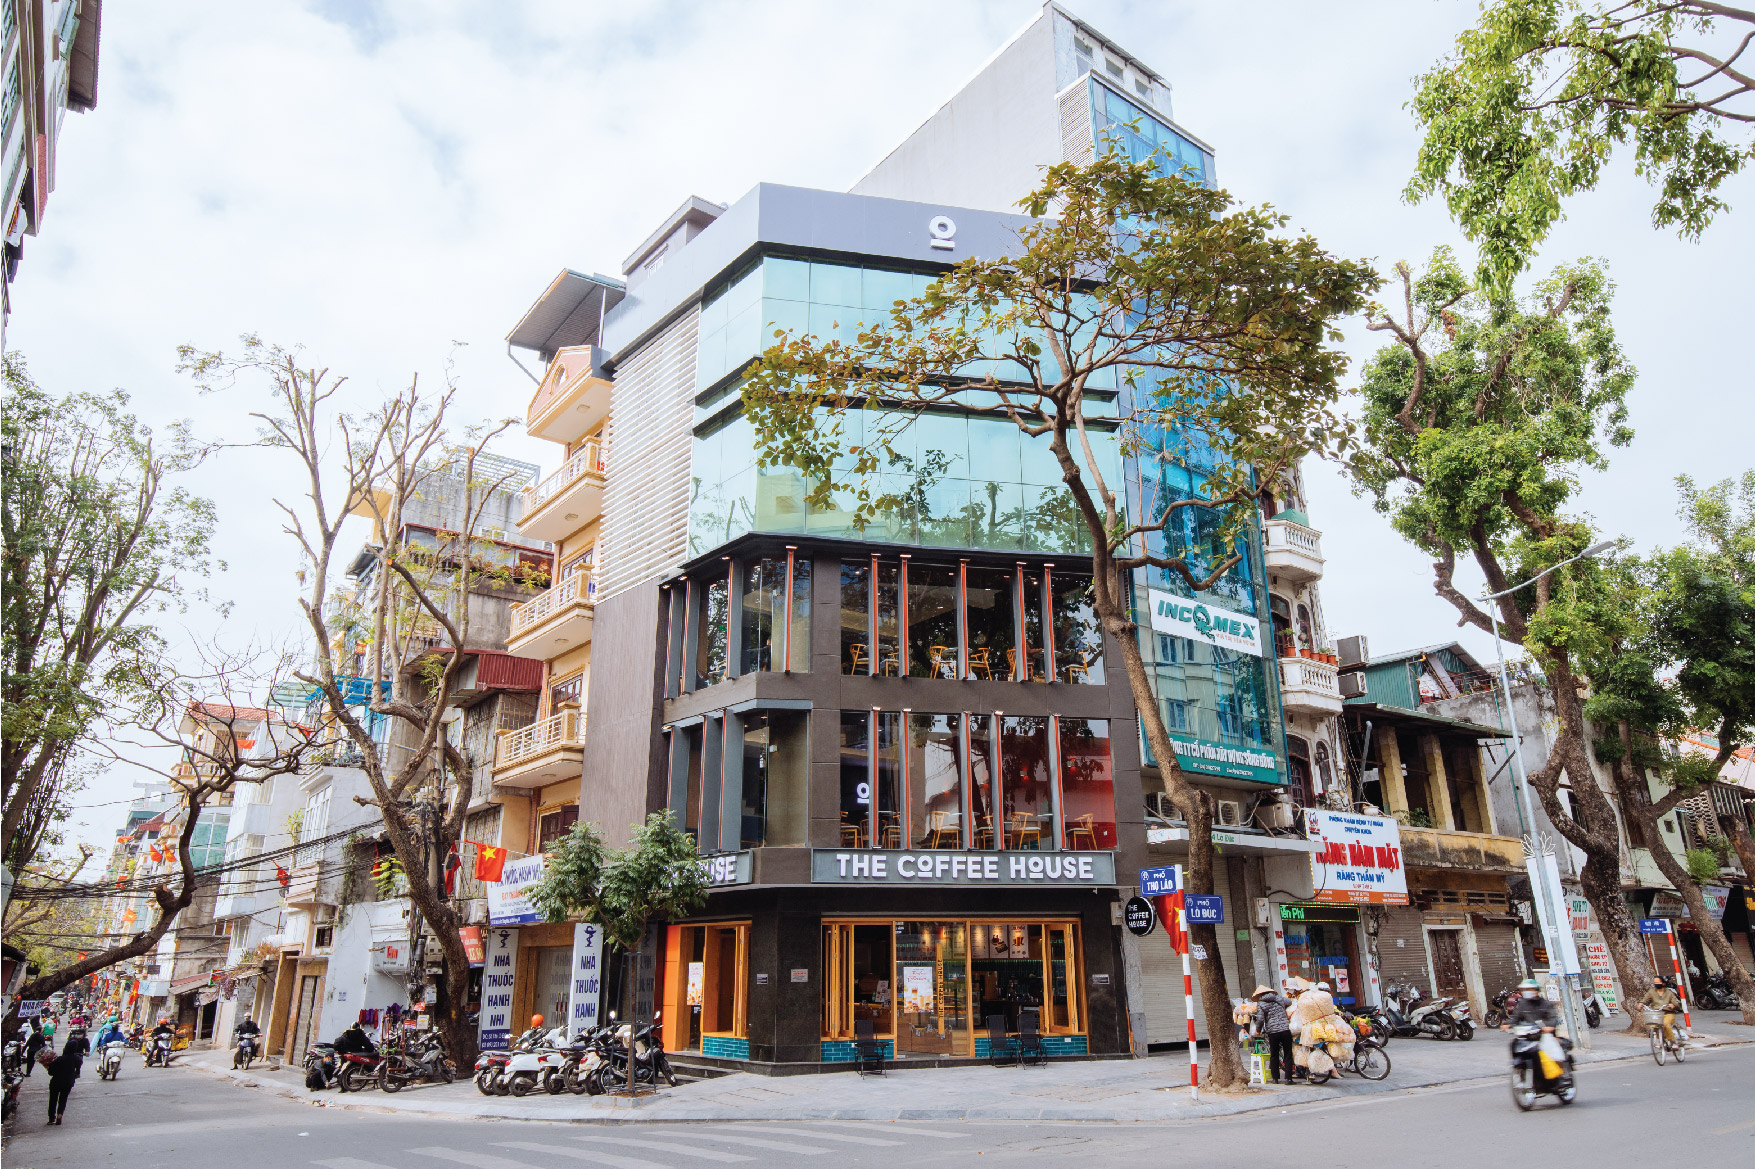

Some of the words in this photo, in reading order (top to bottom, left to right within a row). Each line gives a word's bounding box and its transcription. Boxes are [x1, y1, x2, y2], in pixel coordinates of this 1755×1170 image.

[1158, 599, 1256, 643] INCOMEX
[1348, 840, 1376, 868] HÀM
[1375, 843, 1400, 872] MẶT
[836, 854, 887, 878] THE
[897, 855, 999, 879] COFFEE
[1010, 856, 1094, 880] HOUSE
[1153, 871, 1165, 879] PHỐ
[1337, 870, 1356, 881] RĂNG
[1356, 869, 1375, 883] THẨM
[1147, 882, 1159, 892] THỌ
[1160, 879, 1173, 890] LÃO
[1128, 904, 1138, 912] THE
[1191, 905, 1200, 918] LÒ
[1202, 906, 1217, 918] ĐÚC
[1292, 908, 1305, 920] Phí
[1128, 911, 1149, 920] COFFEE
[1588, 944, 1605, 953] CHÈ
[494, 953, 510, 967] NHÀ
[581, 953, 596, 970] NHÀ
[488, 970, 514, 987] THUỐC
[576, 974, 599, 994] THUỐC
[488, 994, 510, 1009] HẠNH
[575, 1003, 596, 1021] HẠNH
[490, 1014, 504, 1027] NHI
